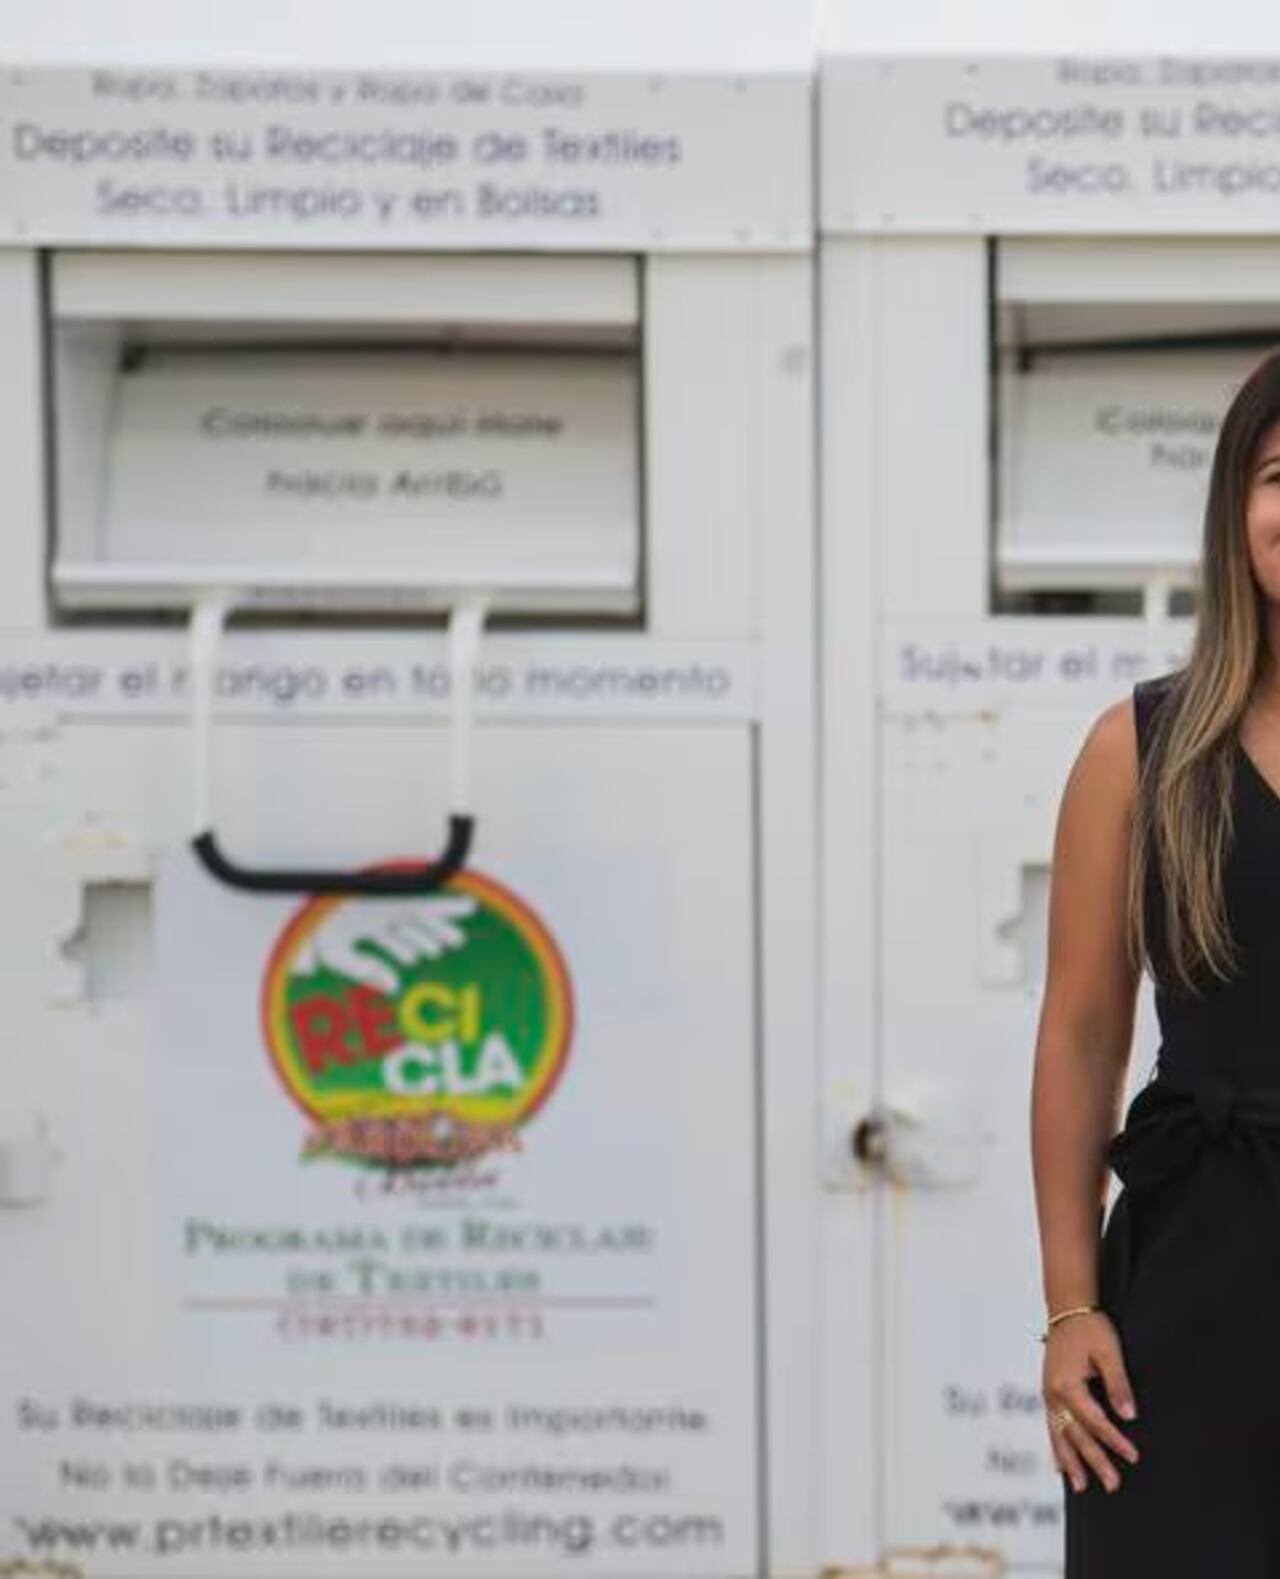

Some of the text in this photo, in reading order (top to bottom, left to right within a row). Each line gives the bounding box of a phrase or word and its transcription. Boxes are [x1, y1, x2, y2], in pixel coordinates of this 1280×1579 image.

[450, 79, 487, 105] de
[946, 102, 1124, 143] Deposite
[1141, 112, 1181, 137] su
[13, 123, 681, 166] Deposite su Reciclaje de Textiles
[226, 183, 362, 221] Limpio
[376, 193, 394, 221] y
[414, 191, 464, 216] en
[478, 183, 600, 217] Bolsas
[118, 662, 157, 698] el
[341, 668, 399, 698] en
[526, 664, 731, 698] momento
[1059, 647, 1097, 682] el
[18, 1402, 58, 1432] Su
[72, 1402, 241, 1436] Reciclaje
[255, 1404, 302, 1432] de
[318, 1402, 440, 1432] Textiles
[456, 1408, 494, 1432] es
[60, 1462, 106, 1492] No
[125, 1462, 156, 1492] lo
[171, 1462, 251, 1496] Deje
[264, 1462, 366, 1492] Fuera
[379, 1462, 439, 1492] del
